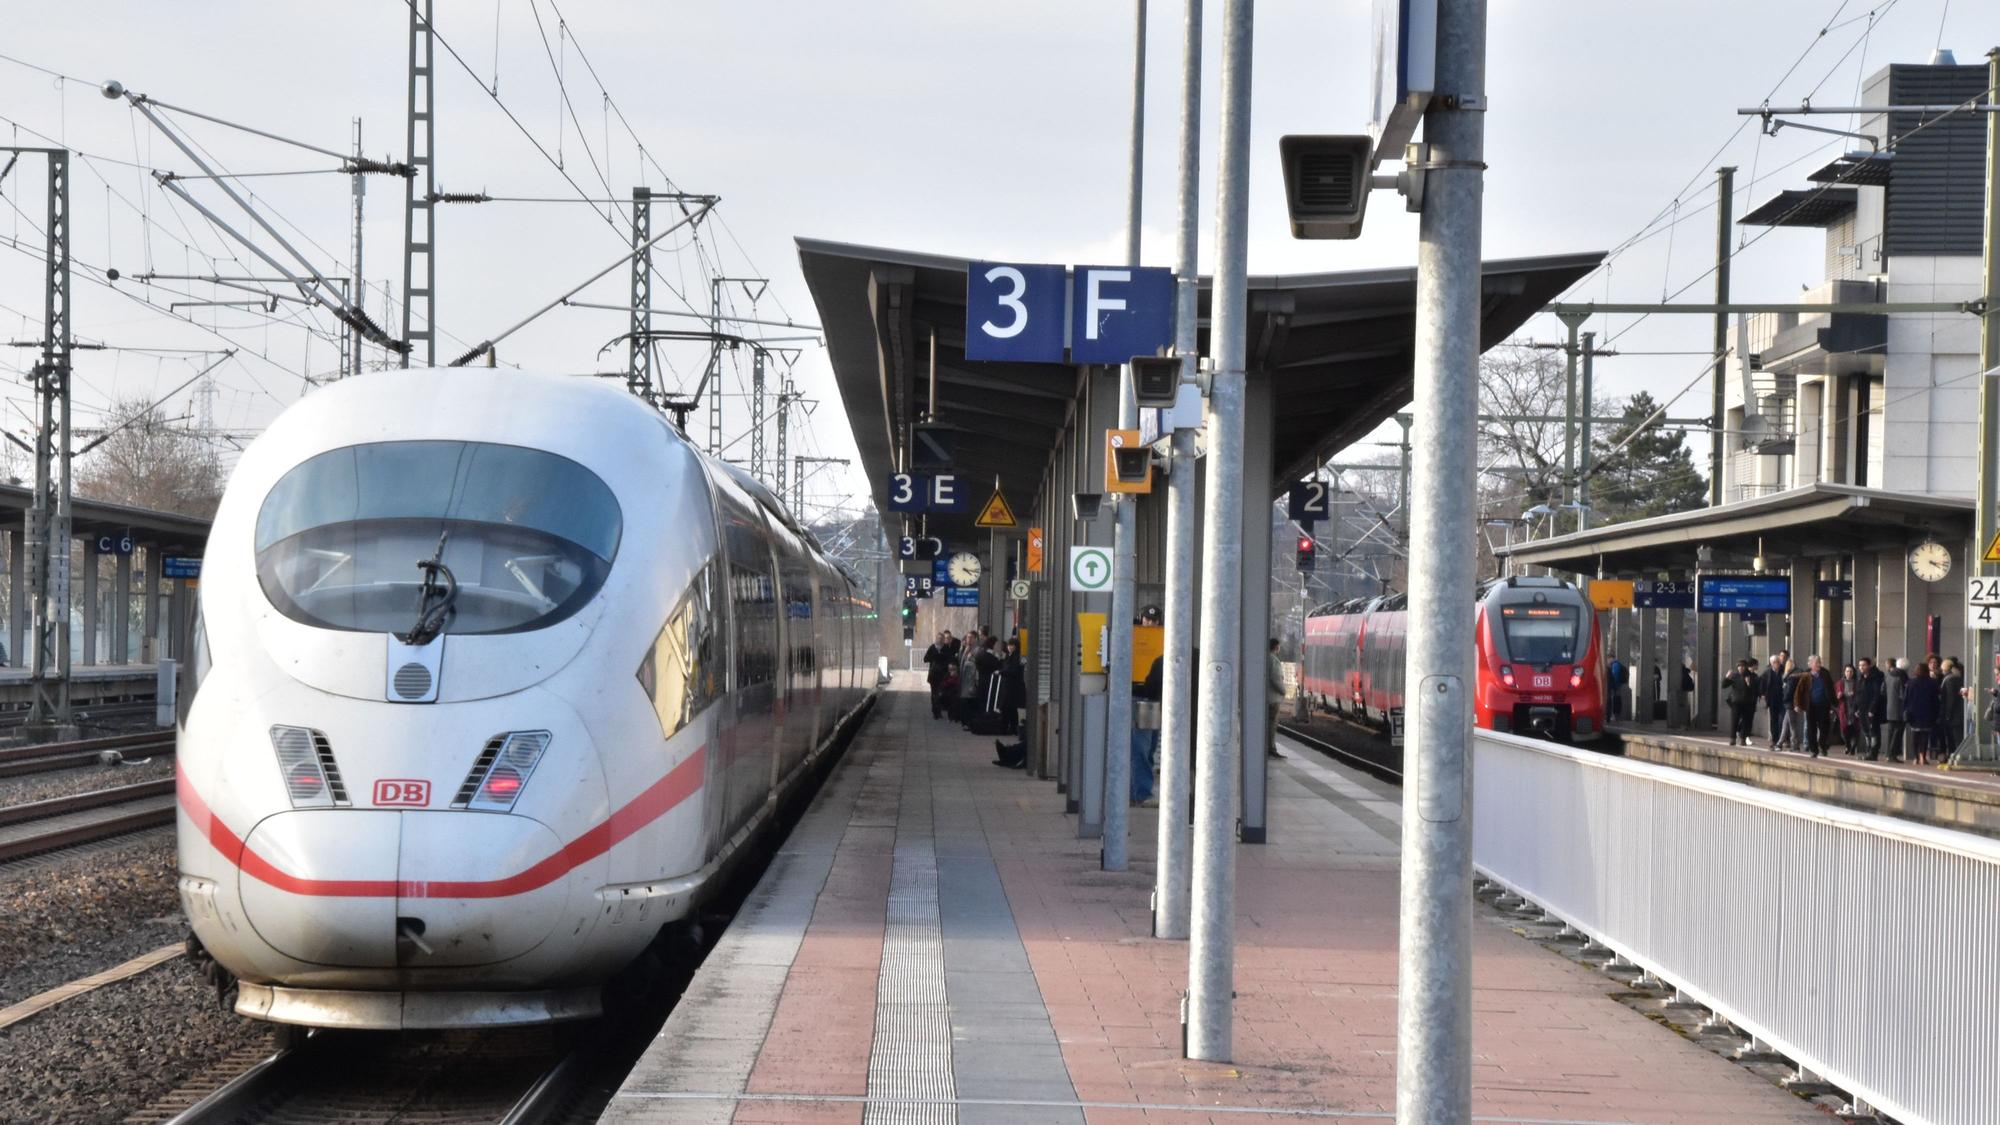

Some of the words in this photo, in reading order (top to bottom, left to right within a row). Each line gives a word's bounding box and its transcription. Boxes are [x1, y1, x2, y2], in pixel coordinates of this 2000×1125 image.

[981, 267, 1028, 338] 3
[1086, 270, 1131, 340] F
[893, 474, 912, 503] 3
[935, 475, 954, 504] E
[1304, 482, 1323, 511] 2
[99, 537, 110, 551] C
[121, 538, 131, 552] 6
[902, 537, 914, 555] 3
[908, 578, 916, 589] 3
[922, 578, 931, 589] B
[1971, 580, 1999, 600] 24
[1978, 606, 1992, 623] 4
[1535, 677, 1550, 687] DB
[379, 782, 425, 802] DB
